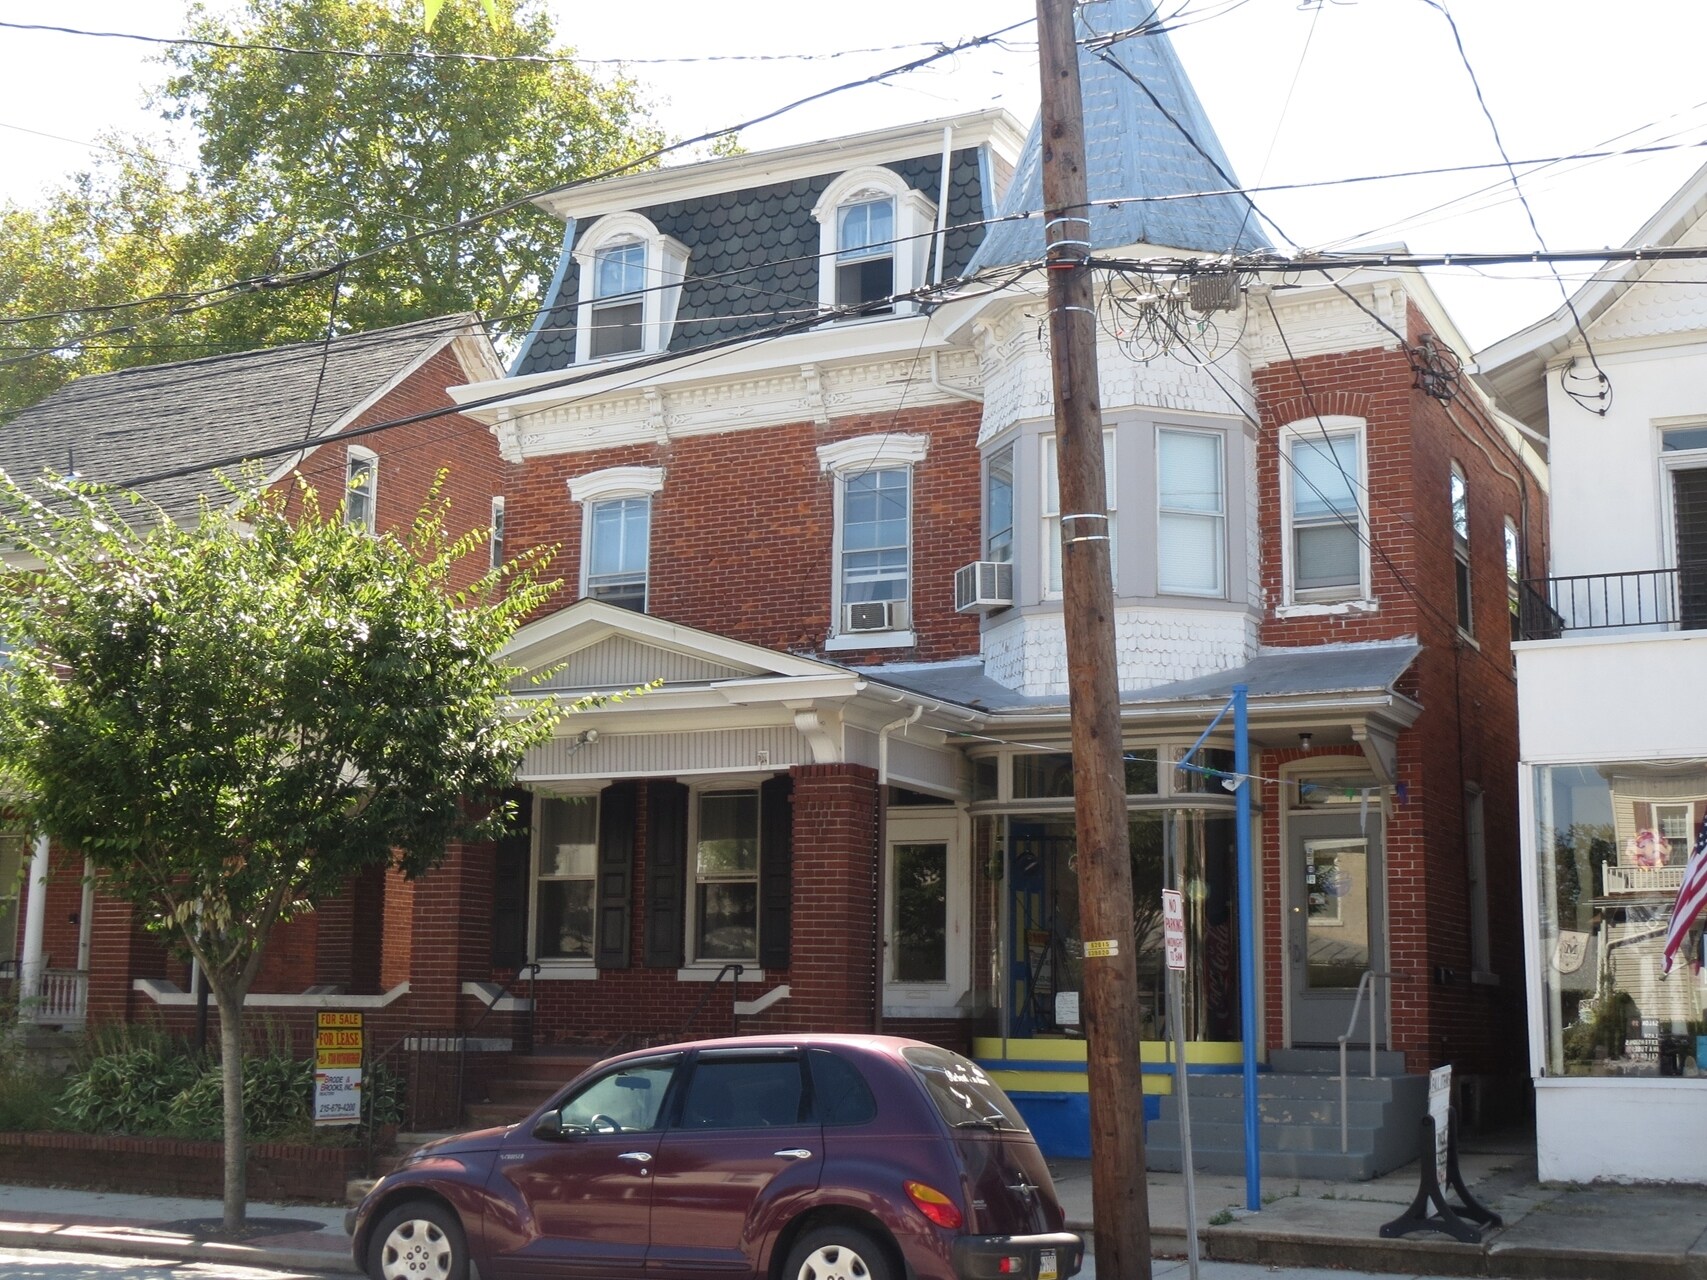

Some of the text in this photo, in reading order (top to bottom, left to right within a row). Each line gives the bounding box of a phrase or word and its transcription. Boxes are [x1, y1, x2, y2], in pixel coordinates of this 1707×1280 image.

[1165, 918, 1183, 932] PARKING
[321, 1013, 358, 1024] FOR SALE
[319, 1032, 360, 1046] FOR LEASE
[325, 1075, 343, 1083] BRODE
[320, 1103, 356, 1112] 215-679-4200
